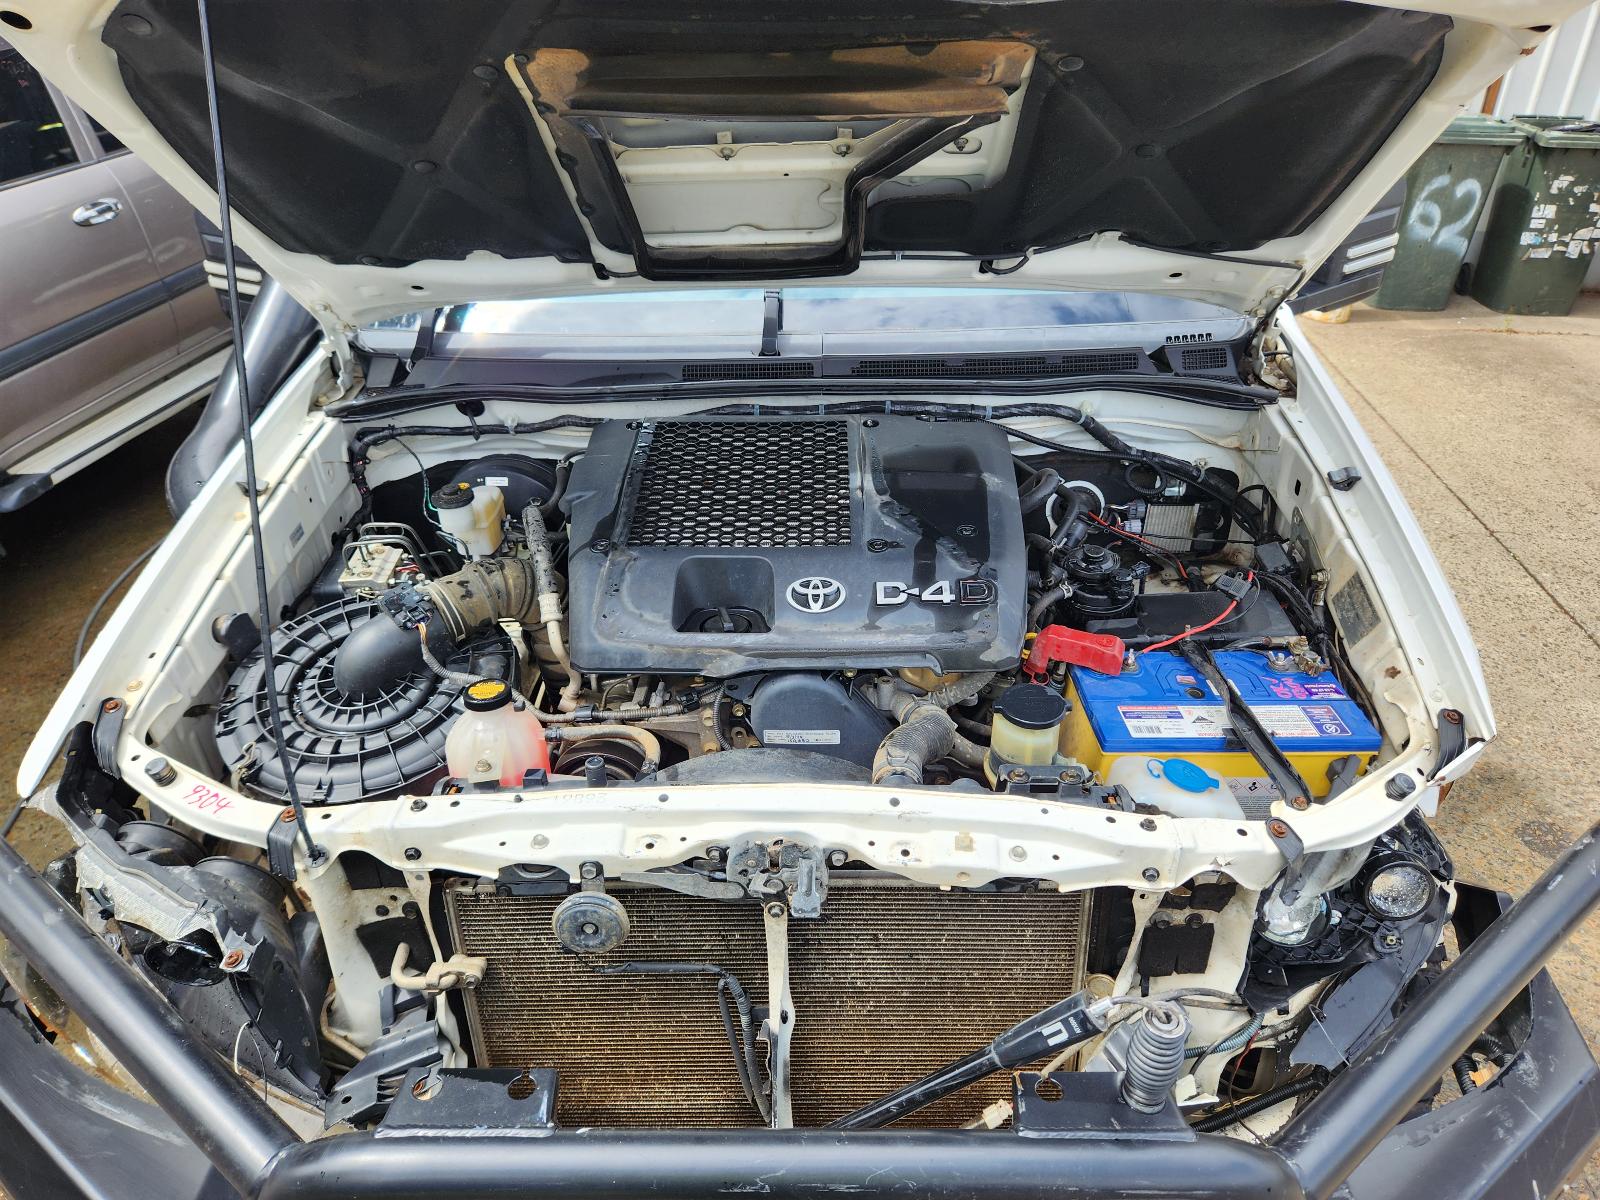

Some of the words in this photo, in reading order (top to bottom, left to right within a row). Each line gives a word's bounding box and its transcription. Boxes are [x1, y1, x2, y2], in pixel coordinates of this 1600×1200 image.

[1408, 174, 1482, 257] 62
[875, 579, 998, 607] D-4D
[183, 784, 235, 815] 9304
